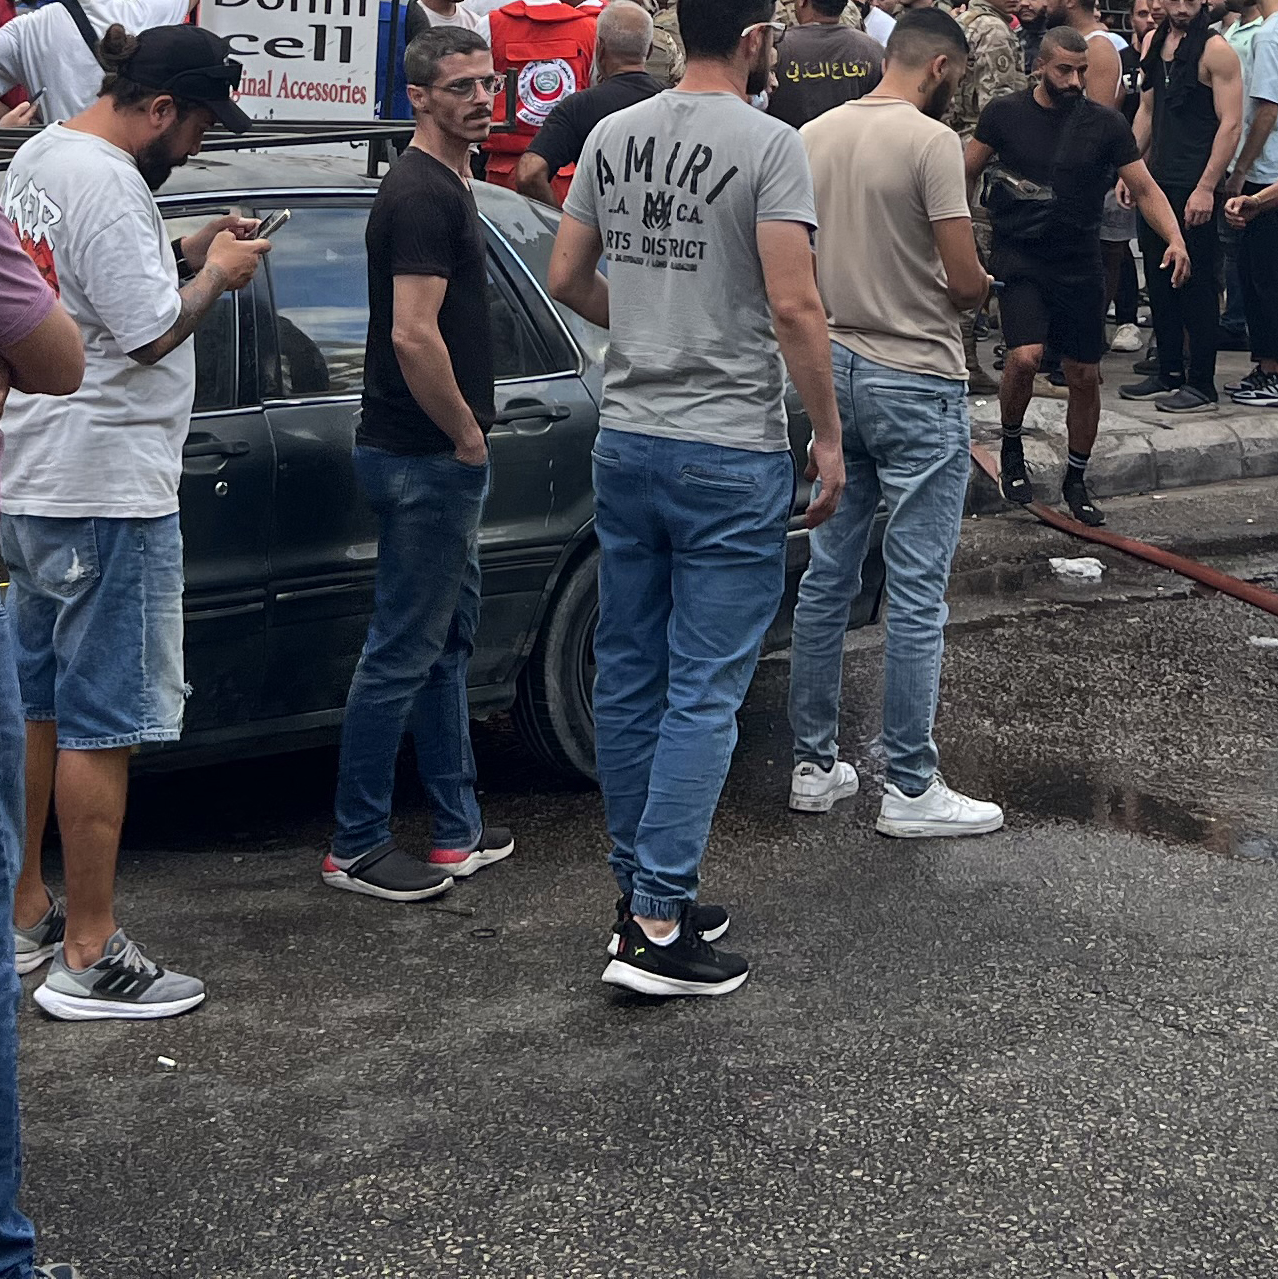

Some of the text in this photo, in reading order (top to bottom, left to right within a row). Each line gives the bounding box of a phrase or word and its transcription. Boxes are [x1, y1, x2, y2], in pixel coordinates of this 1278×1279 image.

[221, 24, 353, 64] cell
[276, 72, 367, 105] Accessories
[595, 135, 739, 206] AMIRI
[605, 229, 709, 260] RTS DISTRICT
